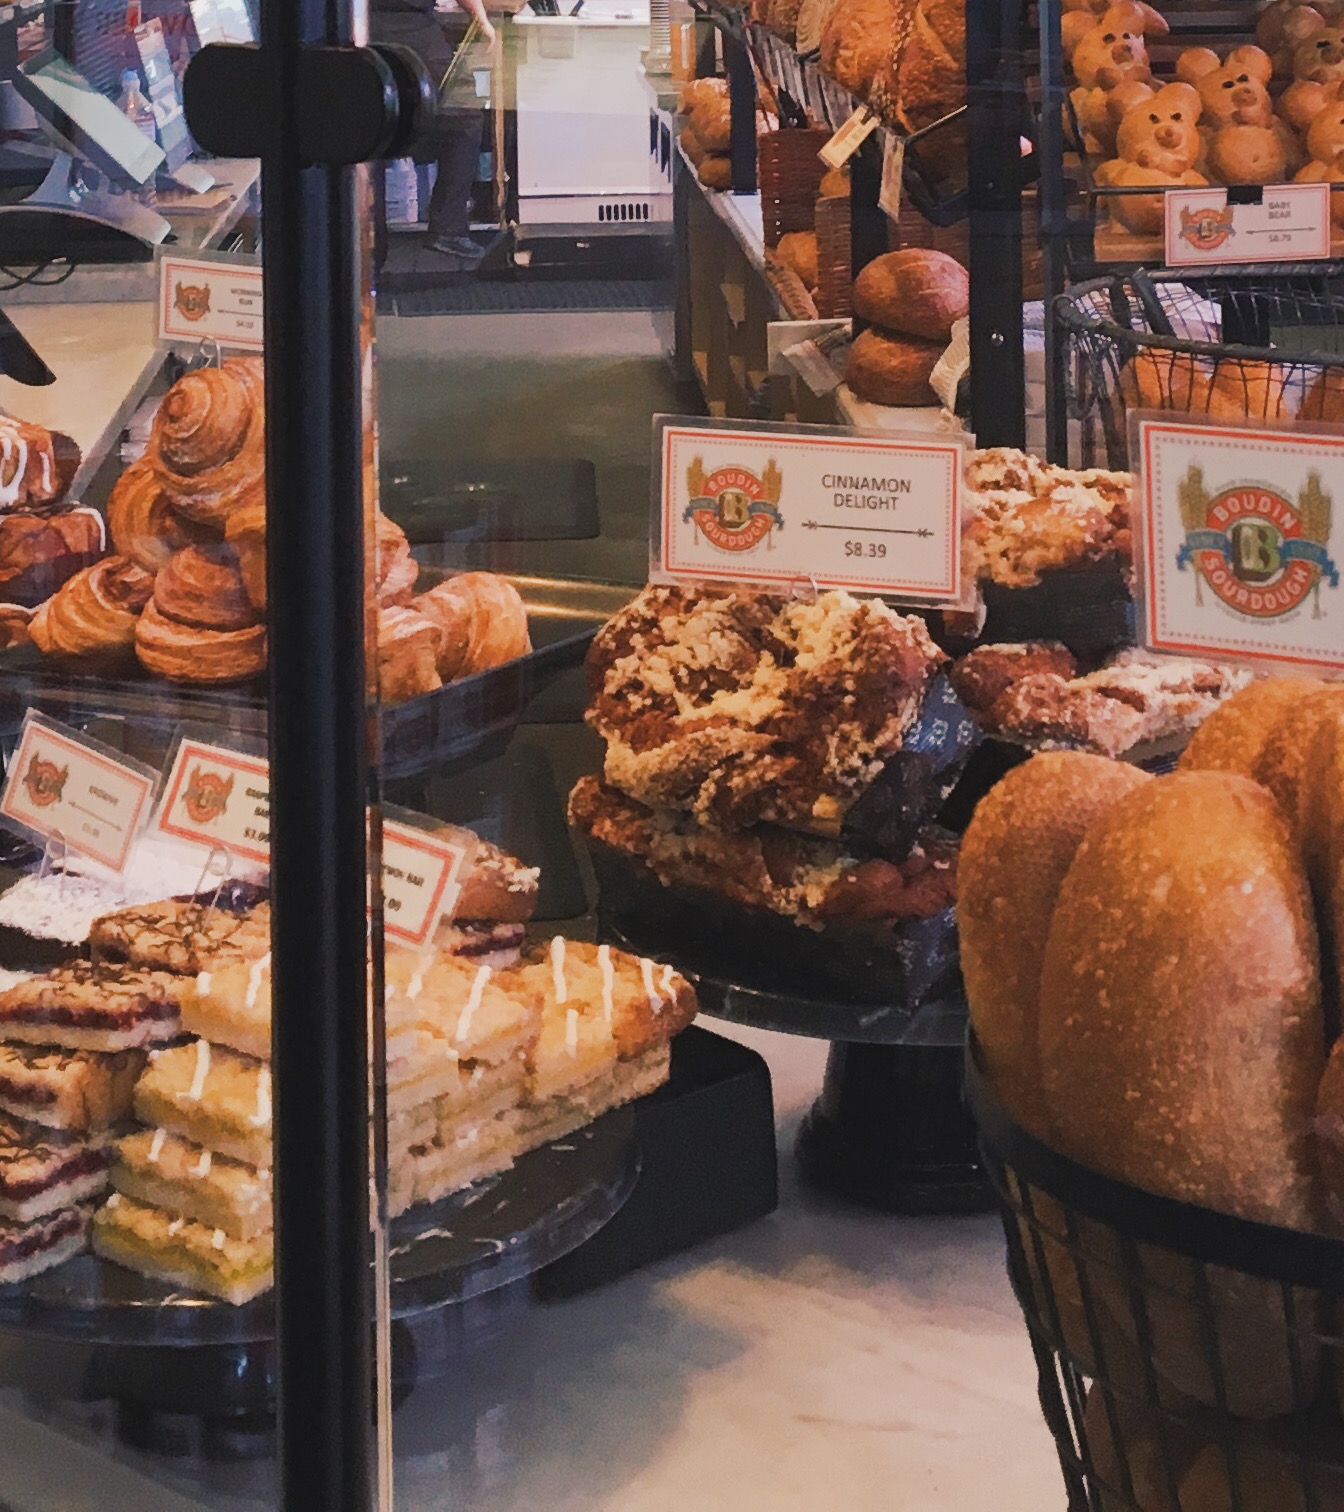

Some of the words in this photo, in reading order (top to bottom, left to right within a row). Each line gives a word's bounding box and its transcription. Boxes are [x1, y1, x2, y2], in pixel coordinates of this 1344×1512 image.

[707, 472, 761, 496] BOUDIN
[821, 473, 913, 494] CINNAMON
[833, 492, 900, 511] DELIGHT
[1212, 493, 1298, 530] BOUDIN
[700, 512, 766, 546] SOURDOUGH
[844, 540, 887, 558] $8.39
[1205, 556, 1310, 611] SOURDOUGH
